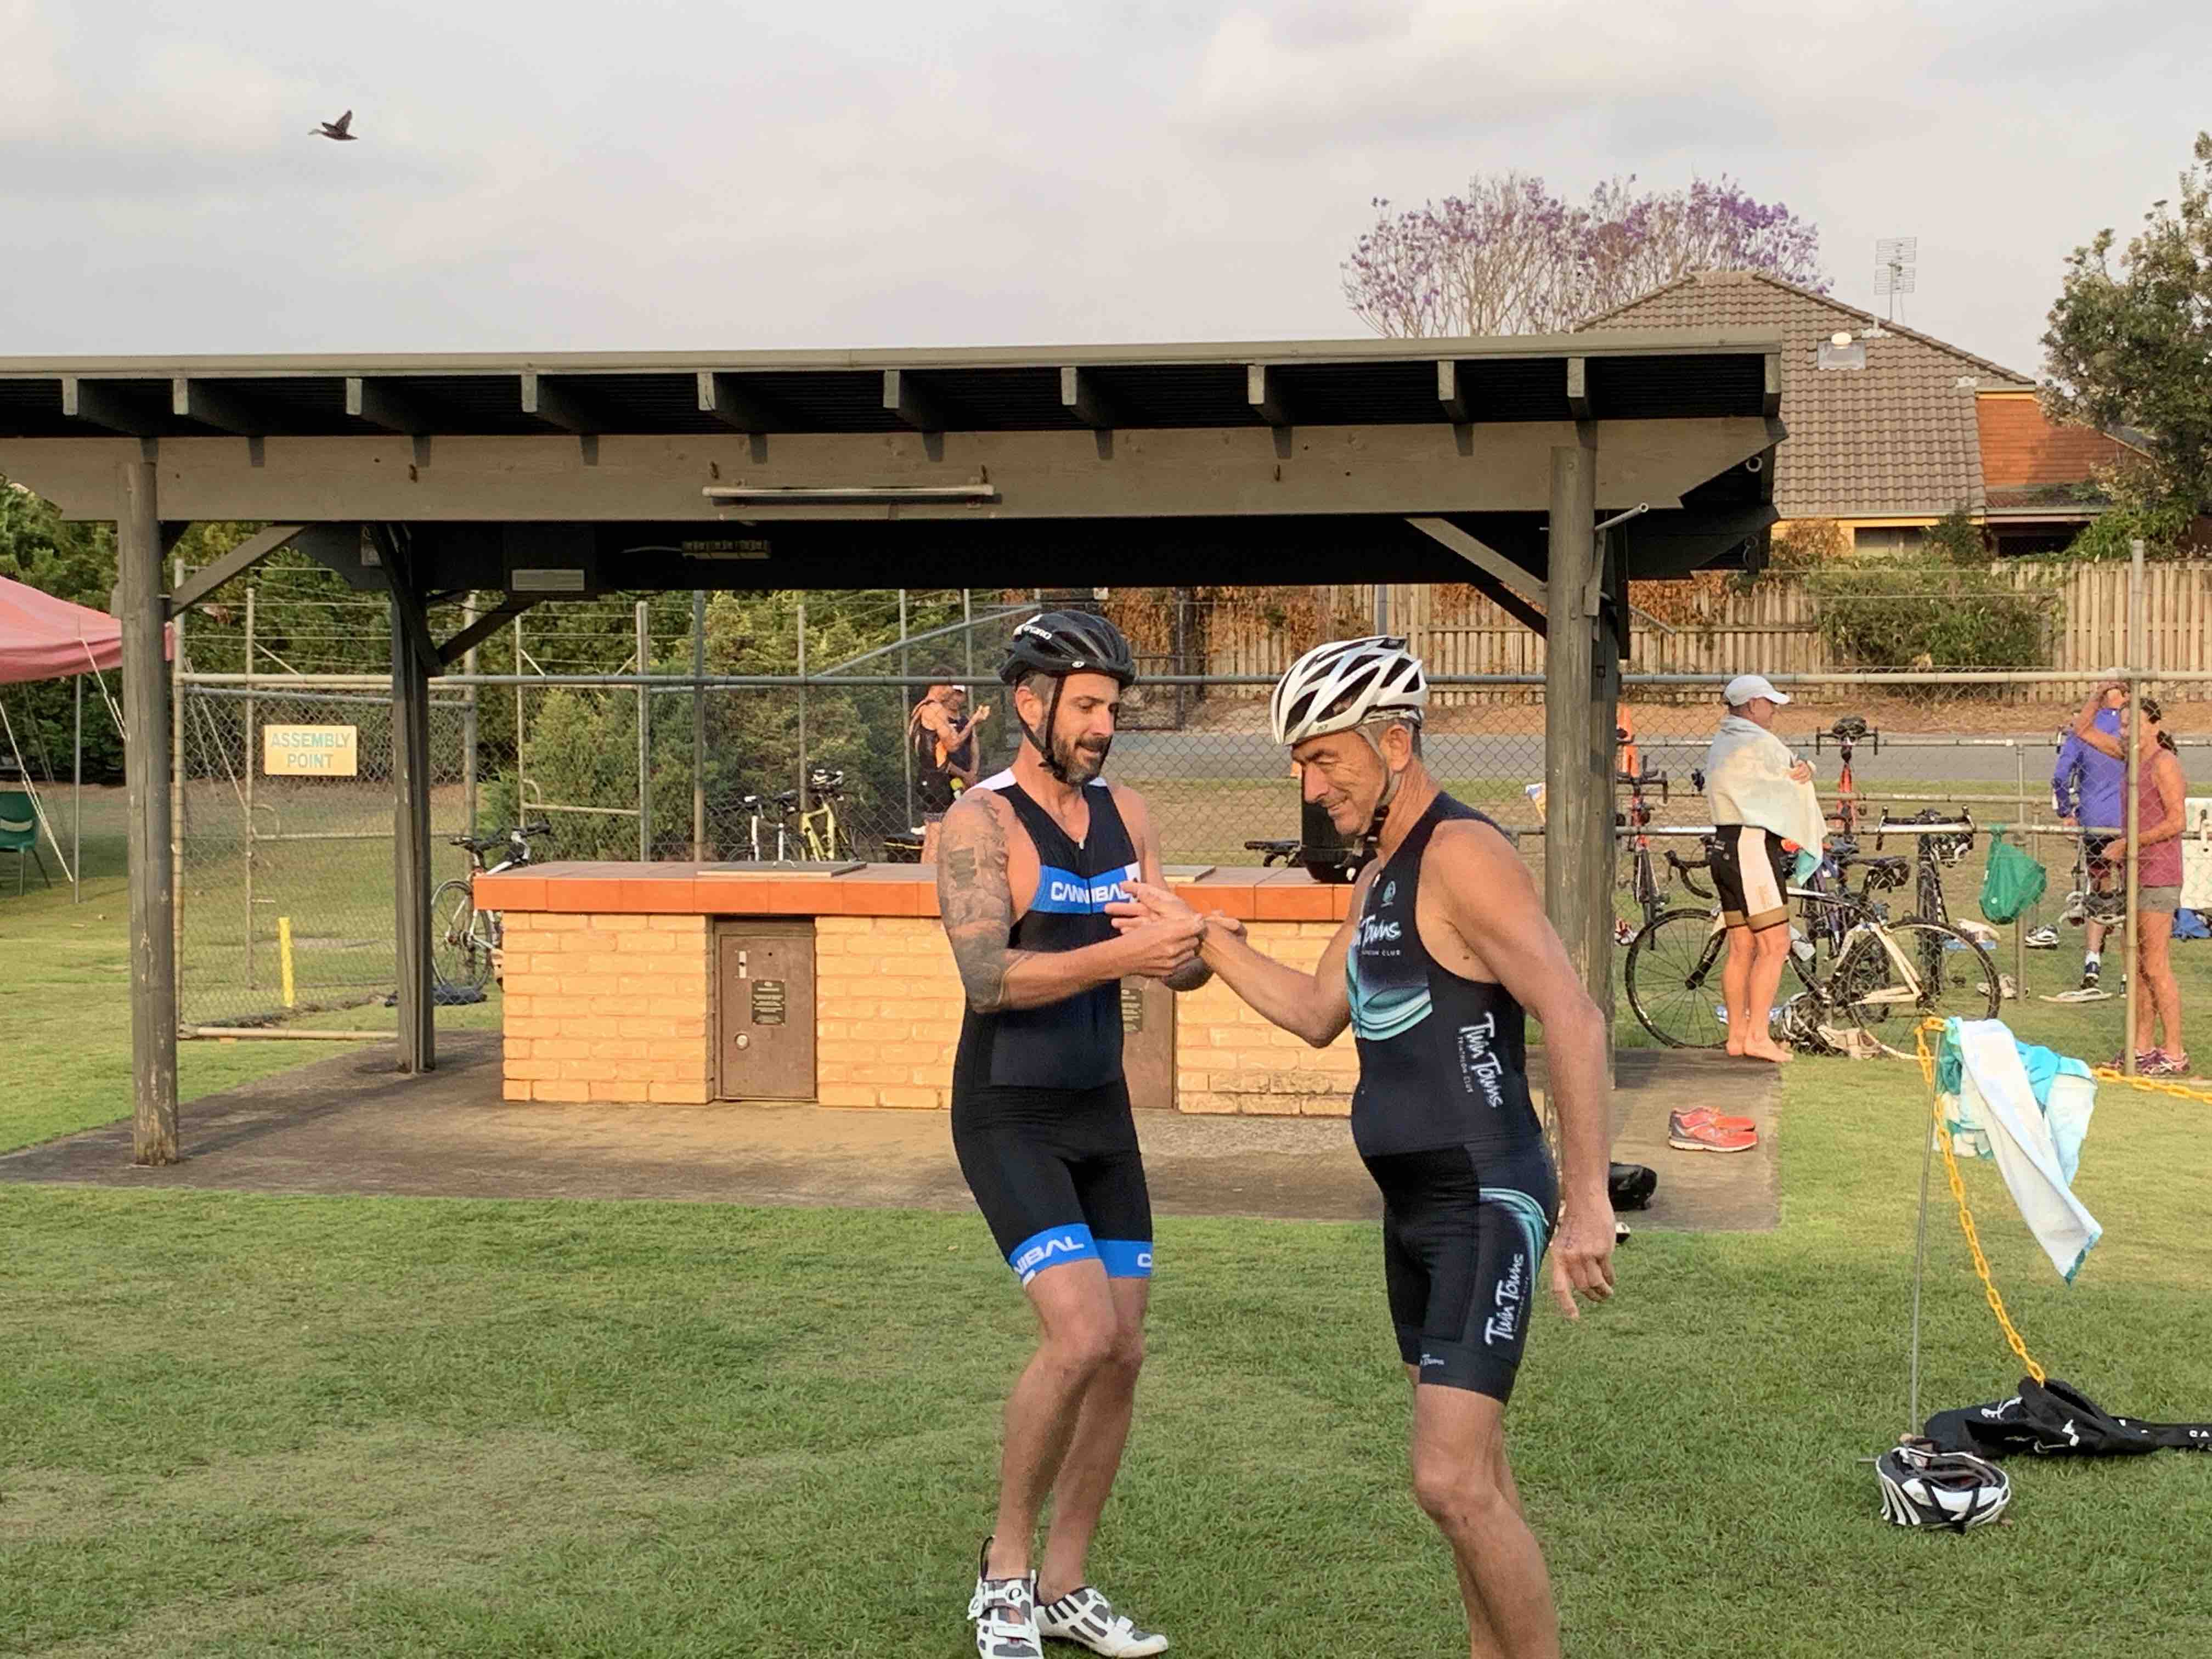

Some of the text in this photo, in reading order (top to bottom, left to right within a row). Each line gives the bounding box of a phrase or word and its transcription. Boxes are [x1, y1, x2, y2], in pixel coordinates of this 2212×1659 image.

[271, 732, 352, 748] ASSEMBLY
[287, 753, 334, 769] POINT
[1459, 1012, 1504, 1108] Twin Towns
[1495, 1253, 1525, 1306] Towns
[1485, 1305, 1515, 1345] Twin
